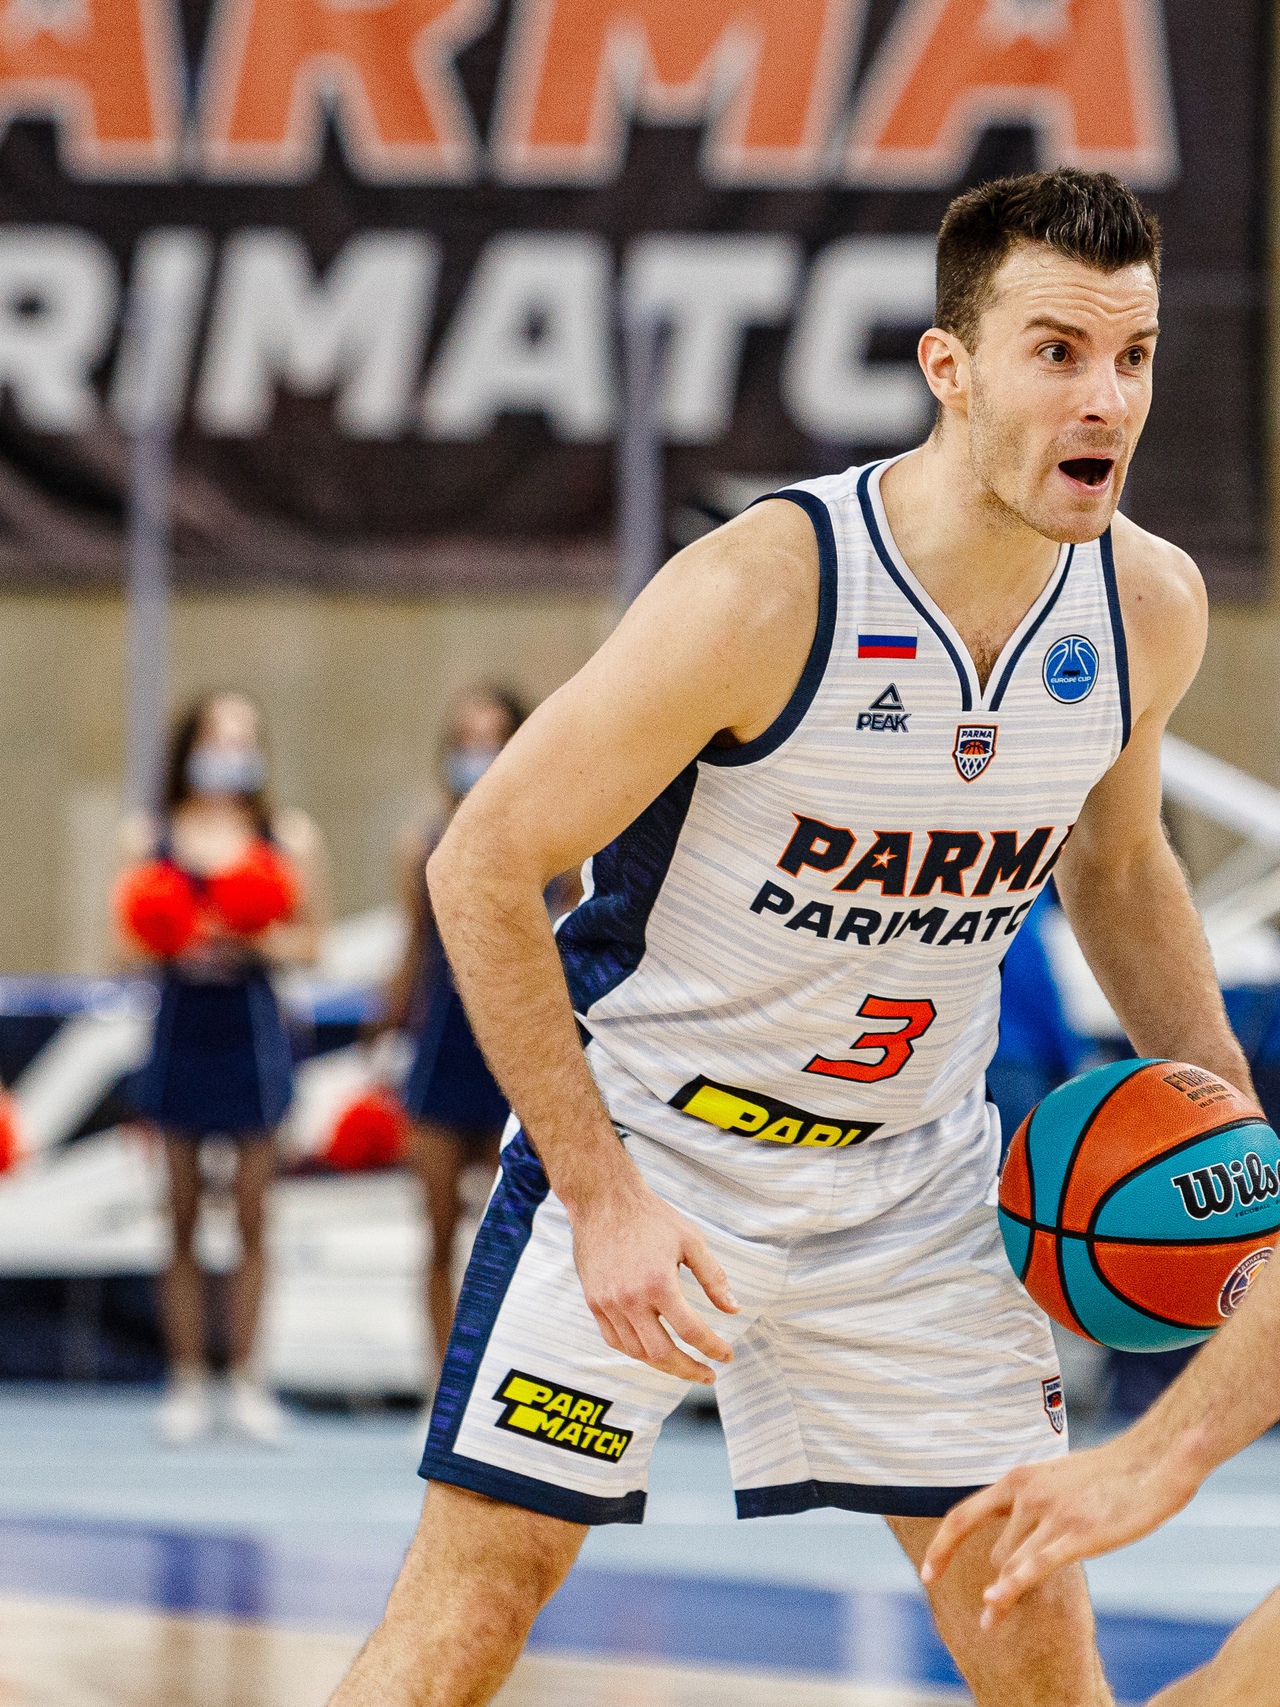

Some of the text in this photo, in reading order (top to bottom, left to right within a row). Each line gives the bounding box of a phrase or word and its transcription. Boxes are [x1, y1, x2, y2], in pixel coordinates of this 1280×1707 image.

[856, 712, 912, 733] PEAK
[961, 730, 993, 739] PARMA
[802, 993, 937, 1084] 3
[503, 1376, 604, 1424] PARI
[507, 1404, 628, 1458] MATCH
